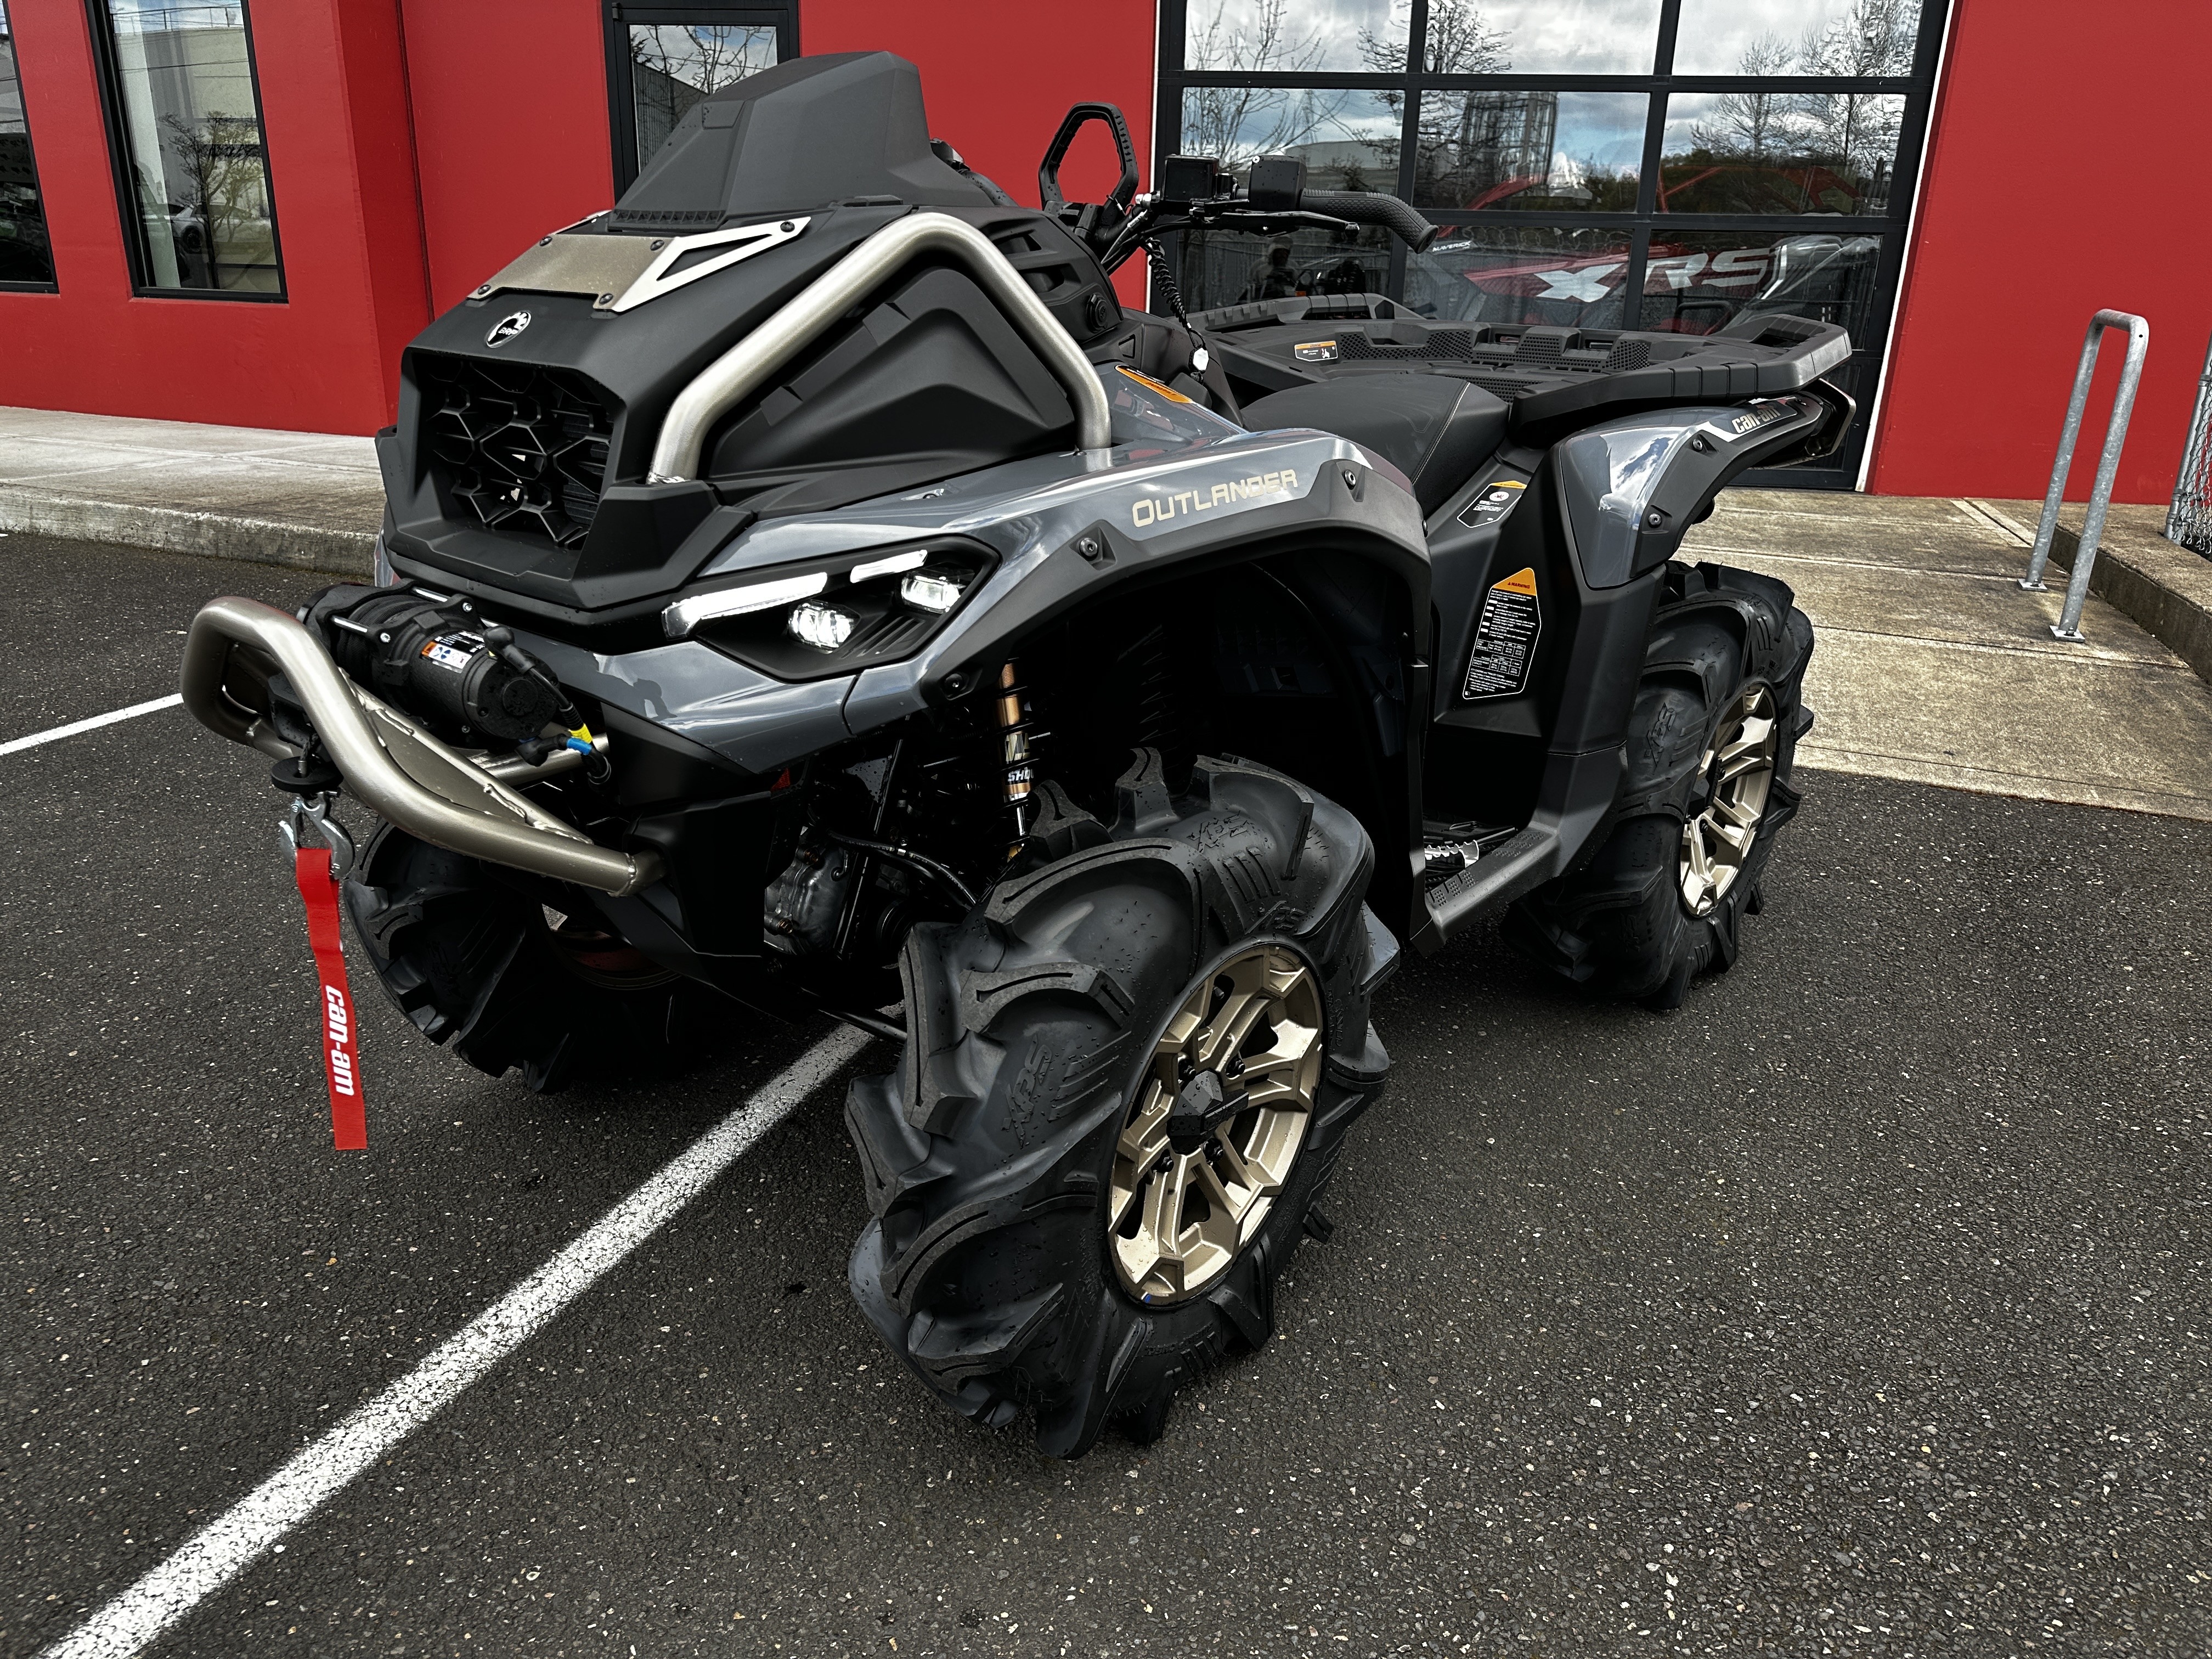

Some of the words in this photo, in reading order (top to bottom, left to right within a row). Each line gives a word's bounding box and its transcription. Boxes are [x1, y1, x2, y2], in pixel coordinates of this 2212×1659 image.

[498, 327, 518, 336] BRP
[1731, 406, 1781, 434] can-am
[1132, 469, 1298, 528] OUTLANDER
[325, 985, 354, 1096] can-am
